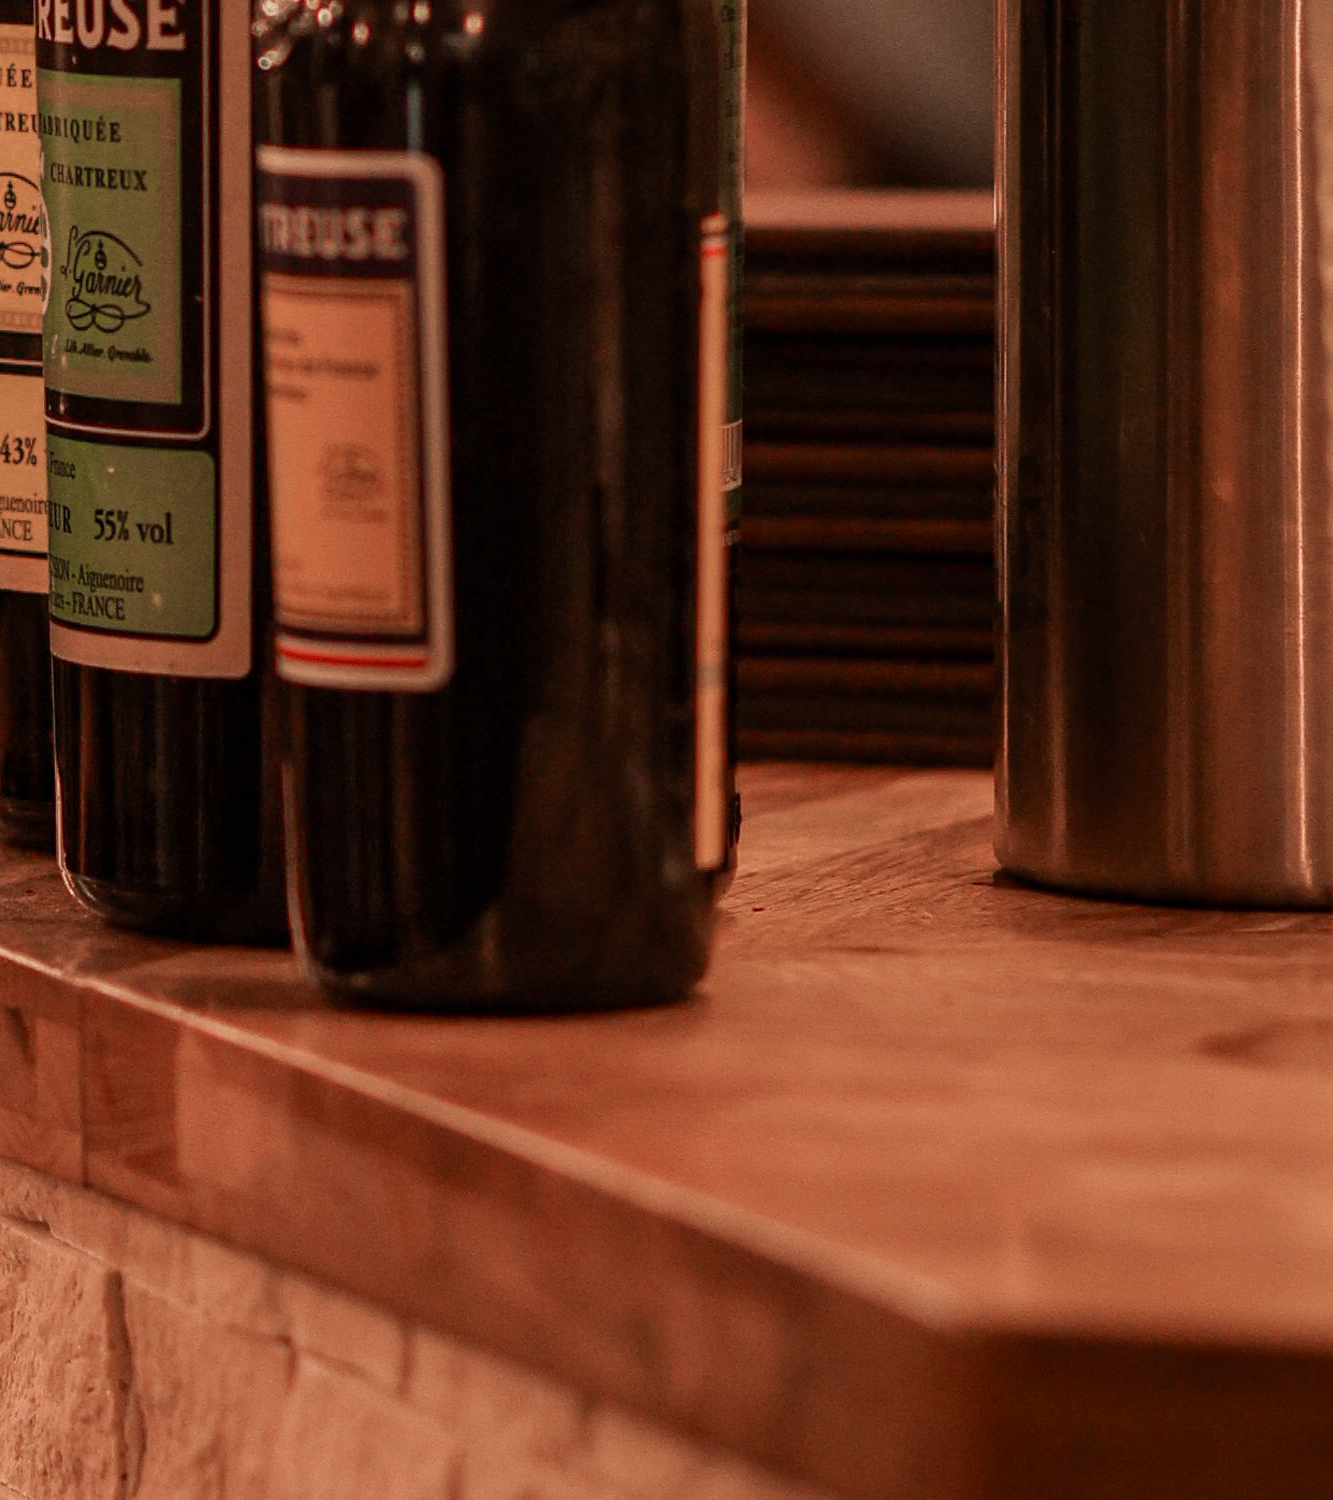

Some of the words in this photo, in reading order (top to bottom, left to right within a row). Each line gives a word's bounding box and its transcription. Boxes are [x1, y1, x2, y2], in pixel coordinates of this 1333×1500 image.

[50, 162, 148, 191] CHARTREUX
[0, 433, 37, 466] 43%
[94, 508, 130, 541] 55%
[136, 511, 174, 544] vol
[72, 591, 126, 620] FRANCE
